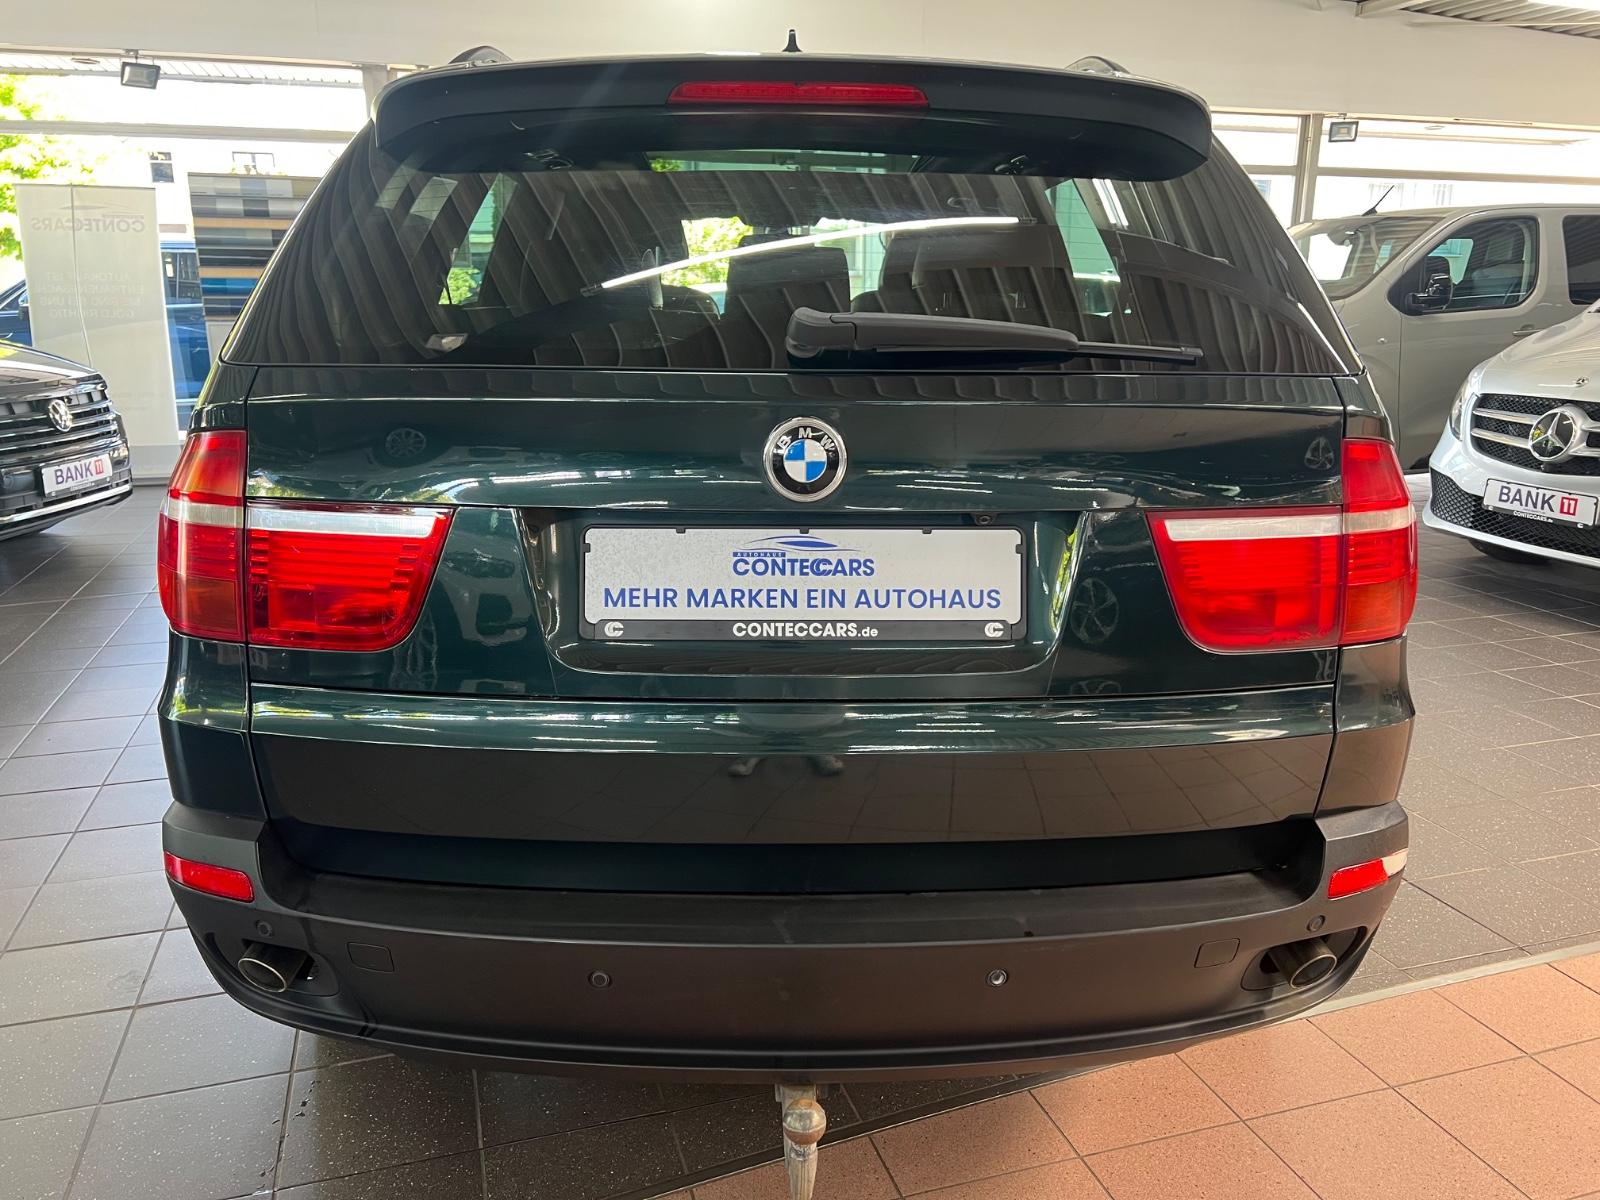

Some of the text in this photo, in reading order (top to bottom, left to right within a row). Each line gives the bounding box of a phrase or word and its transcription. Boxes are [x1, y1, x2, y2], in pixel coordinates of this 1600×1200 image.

[773, 427, 836, 455] BMW
[54, 461, 93, 485] BANK
[1498, 485, 1578, 516] BANK 11
[603, 588, 1001, 609] MEHR MARKEN EIN AUTOHAUS
[732, 622, 879, 638] CONTECCARS.de
